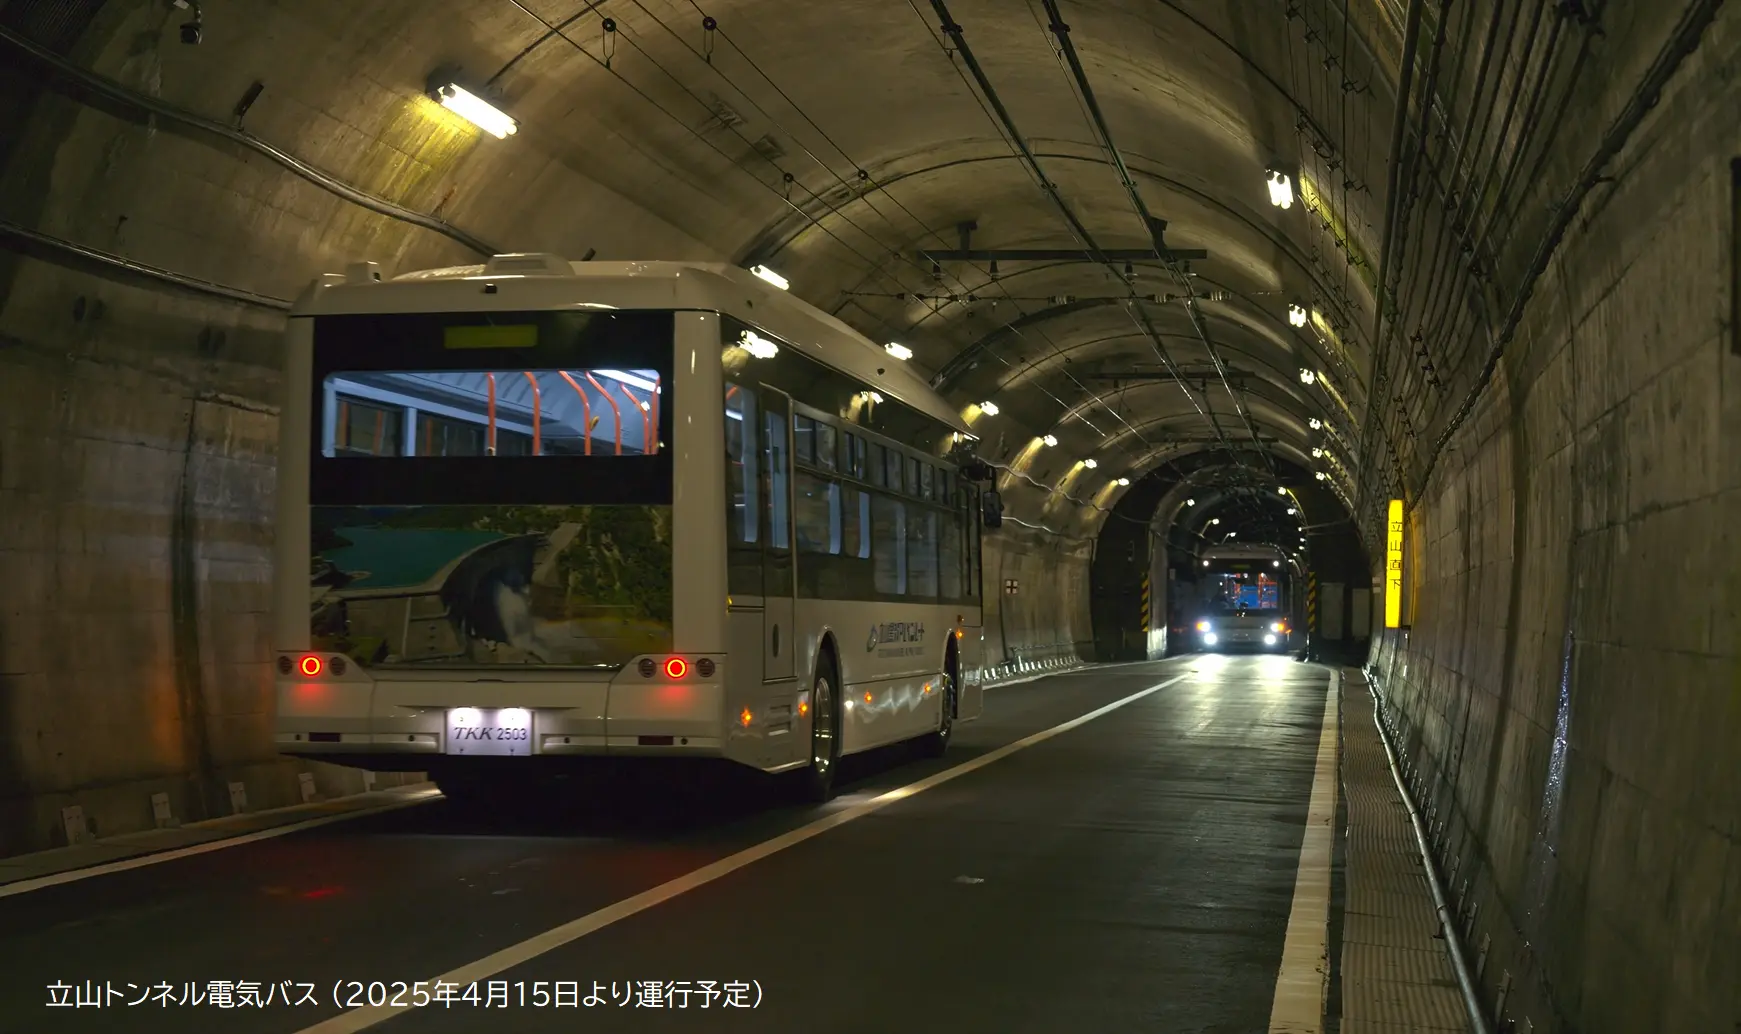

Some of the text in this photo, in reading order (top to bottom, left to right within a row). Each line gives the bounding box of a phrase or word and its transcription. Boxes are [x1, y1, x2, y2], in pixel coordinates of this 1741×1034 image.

[1389, 520, 1402, 590] 立山直下
[454, 727, 527, 740] TKK 2503
